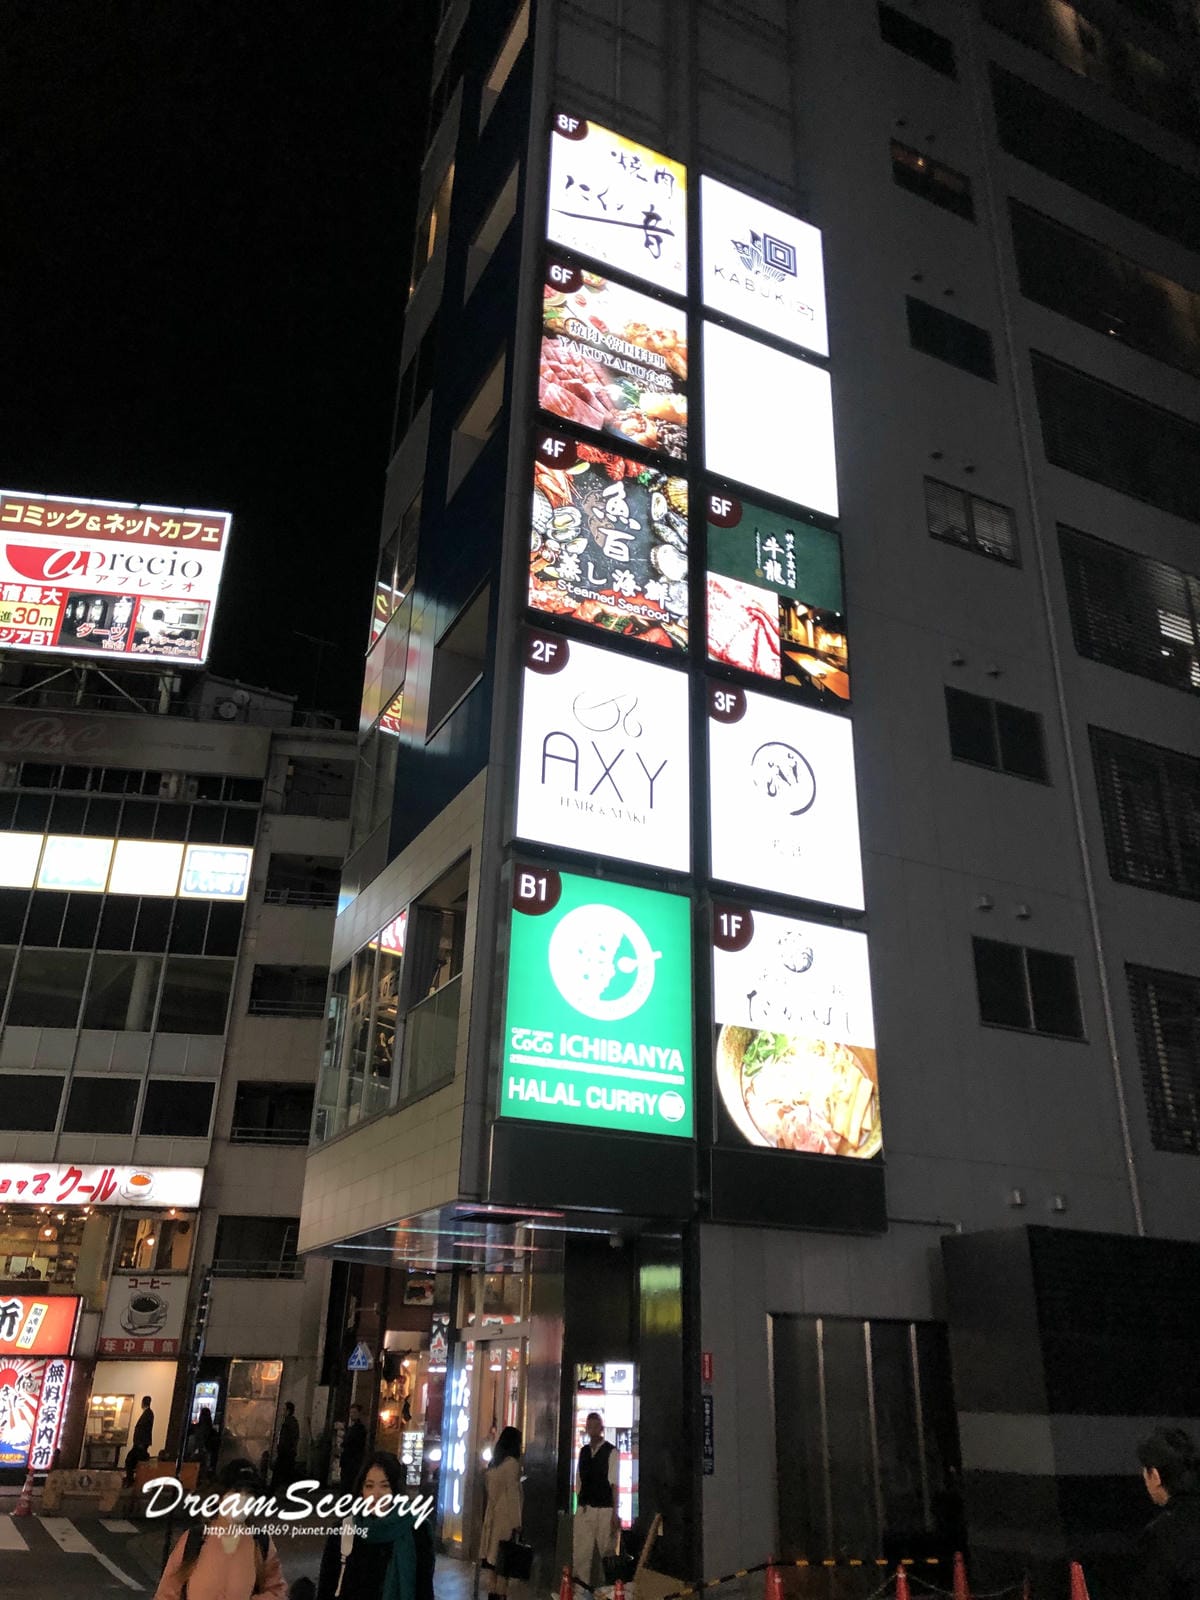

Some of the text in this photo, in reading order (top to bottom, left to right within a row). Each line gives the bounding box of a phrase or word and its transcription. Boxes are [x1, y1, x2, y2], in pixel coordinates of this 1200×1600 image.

[556, 114, 579, 133] 8F
[550, 264, 574, 284] 6F
[542, 437, 566, 457] 4F
[711, 496, 732, 518] 5F
[556, 551, 672, 610] 蒸し海鮮
[557, 580, 670, 622] Steamed Seafood
[76, 622, 128, 640] ダーツ
[532, 641, 558, 664] 2F
[714, 691, 737, 714] 3F
[540, 731, 668, 809] AXY
[519, 874, 547, 901] B1
[719, 913, 743, 937] 1F
[560, 1033, 684, 1072] ICHIBANYA
[508, 1076, 658, 1116] HALAL CURRY
[56, 1166, 118, 1202] クール
[128, 1278, 171, 1289] コーヒー
[32, 1364, 65, 1465] 無料案内所
